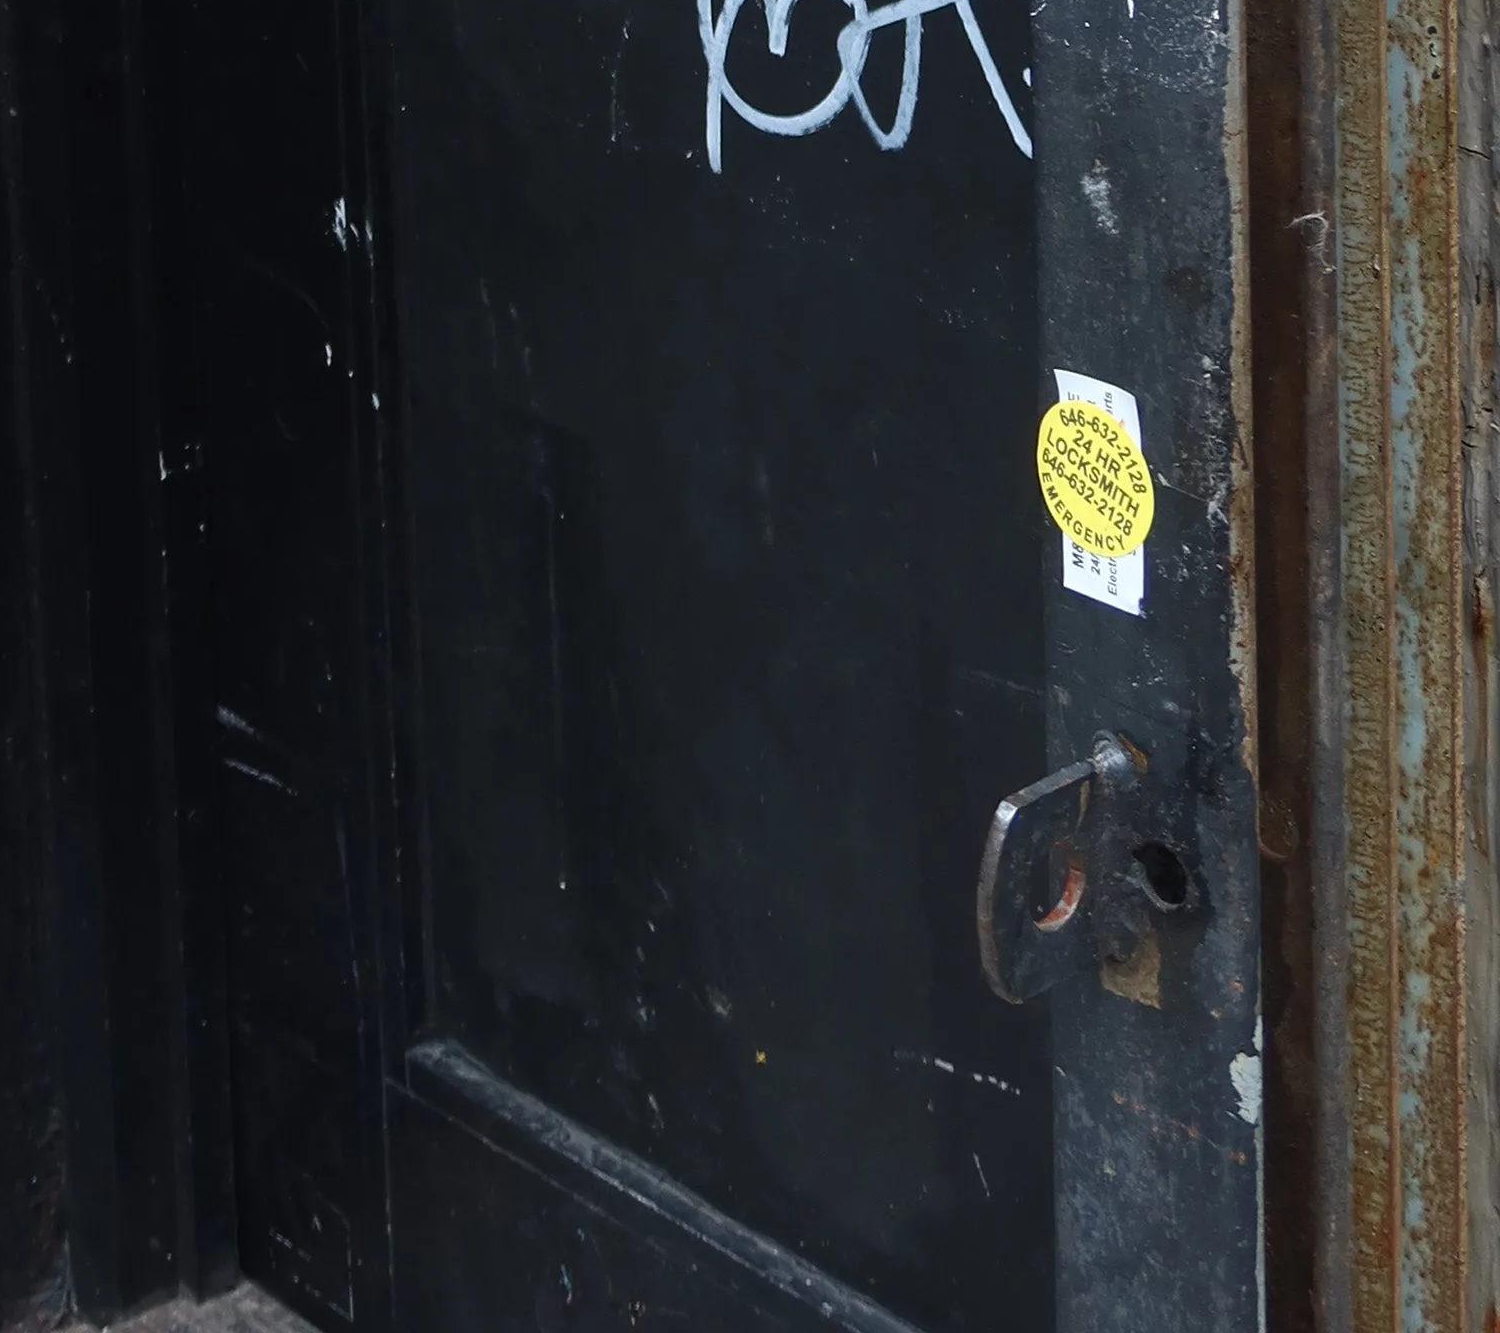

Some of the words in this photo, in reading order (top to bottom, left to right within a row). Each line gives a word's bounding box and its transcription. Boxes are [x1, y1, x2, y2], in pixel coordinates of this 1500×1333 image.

[1042, 448, 1134, 537] 646-632-2128
[1047, 427, 1140, 518] LOCKSMITH
[1060, 407, 1147, 495] 646-632-2128
[1072, 429, 1093, 455] 24
[1096, 447, 1122, 480] HR
[1042, 471, 1126, 552] EMERGENCY
